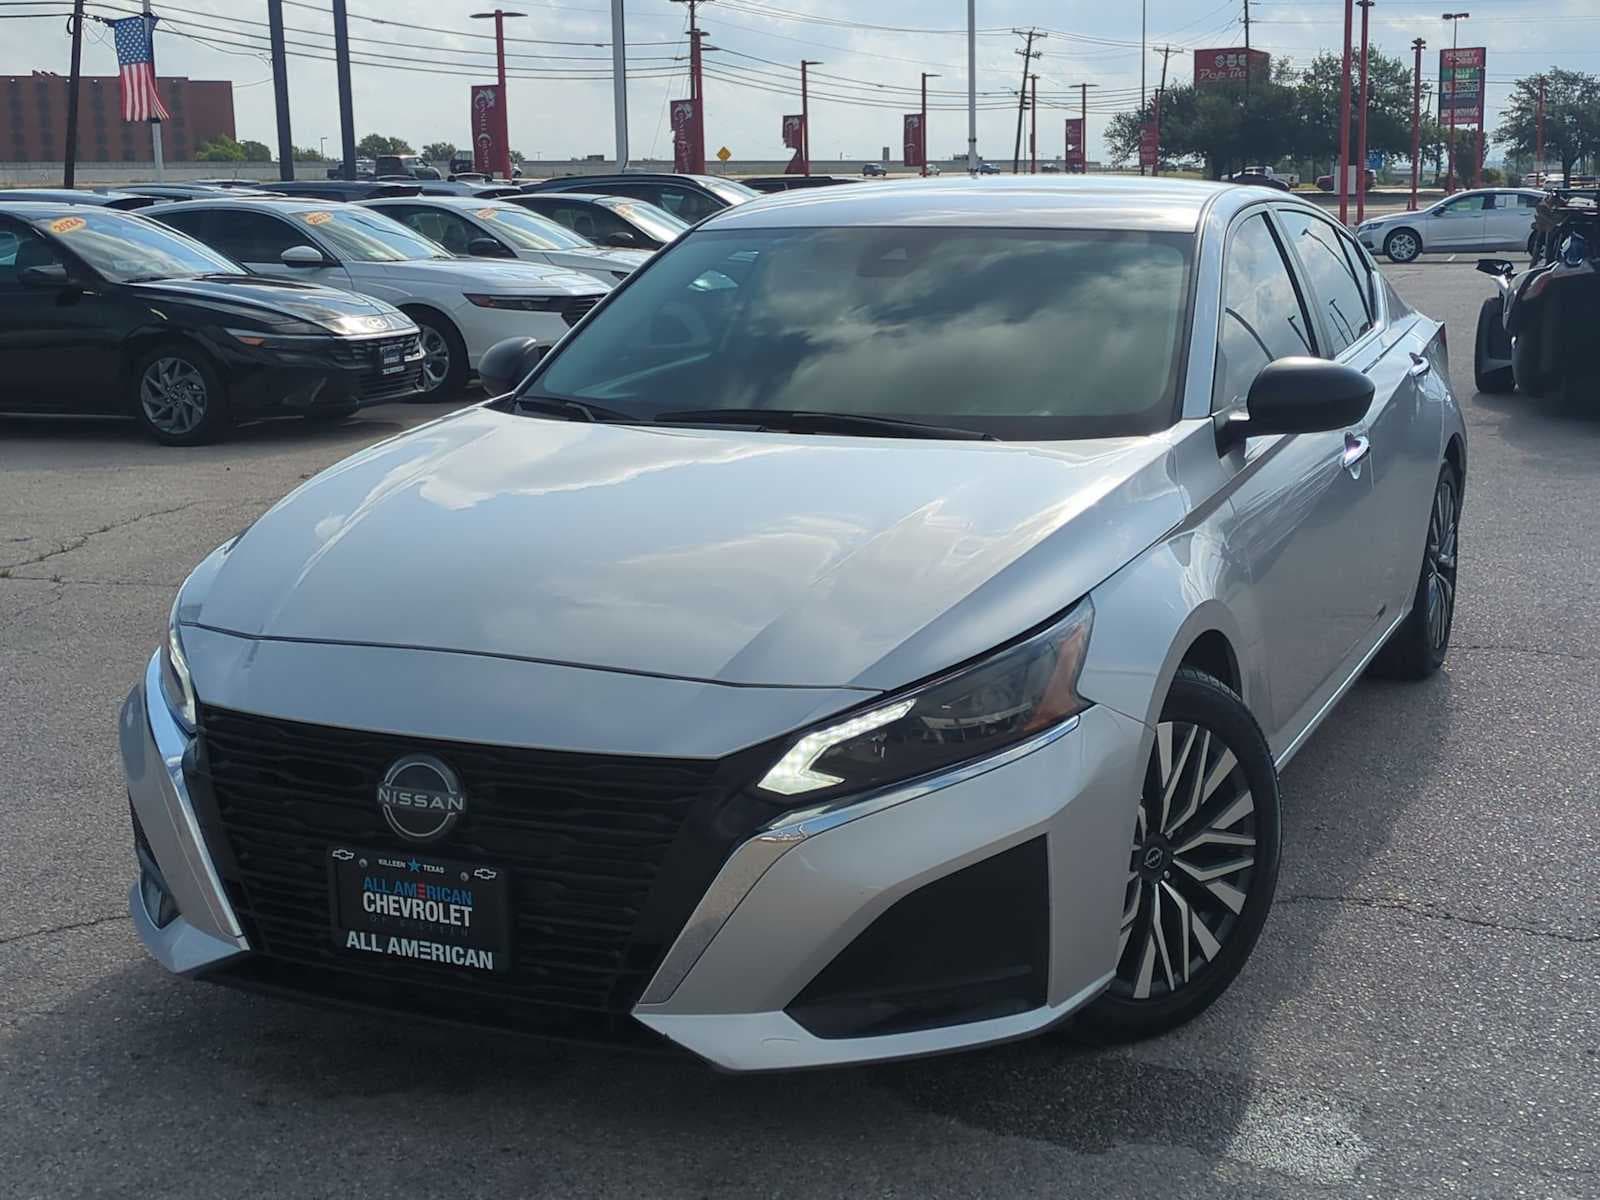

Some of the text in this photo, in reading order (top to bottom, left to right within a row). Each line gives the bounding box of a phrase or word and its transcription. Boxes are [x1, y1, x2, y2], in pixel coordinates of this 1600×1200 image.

[377, 787, 465, 811] NISSAN
[378, 859, 445, 874] KILLEEN TEXAS
[362, 876, 473, 906] ALL AMERICAN
[362, 892, 473, 928] CHEVROLET
[346, 930, 494, 971] ALL AMERICAN
